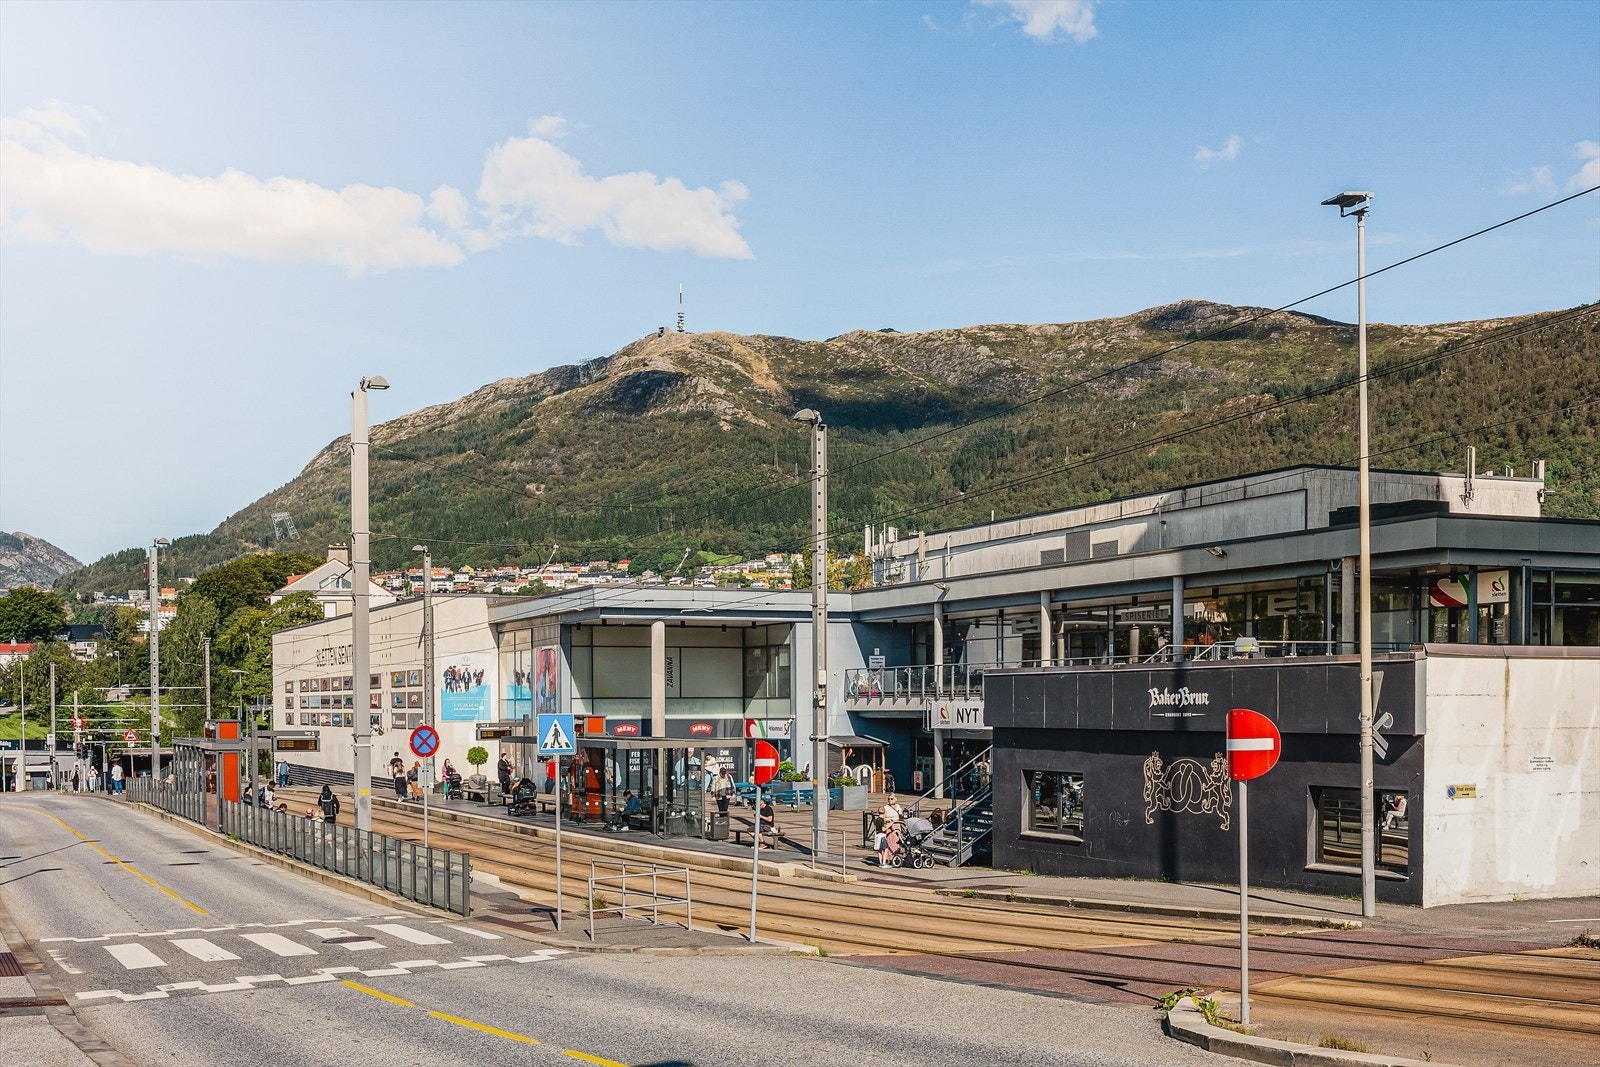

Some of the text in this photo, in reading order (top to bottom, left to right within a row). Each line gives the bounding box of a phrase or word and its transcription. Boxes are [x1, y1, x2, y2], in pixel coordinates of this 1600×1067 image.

[1124, 609, 1164, 621] SPISERIET
[666, 656, 674, 689] ZAVANNA
[1147, 686, 1210, 709] BakerBrun
[956, 707, 980, 724] NYT
[692, 725, 711, 733] MENY
